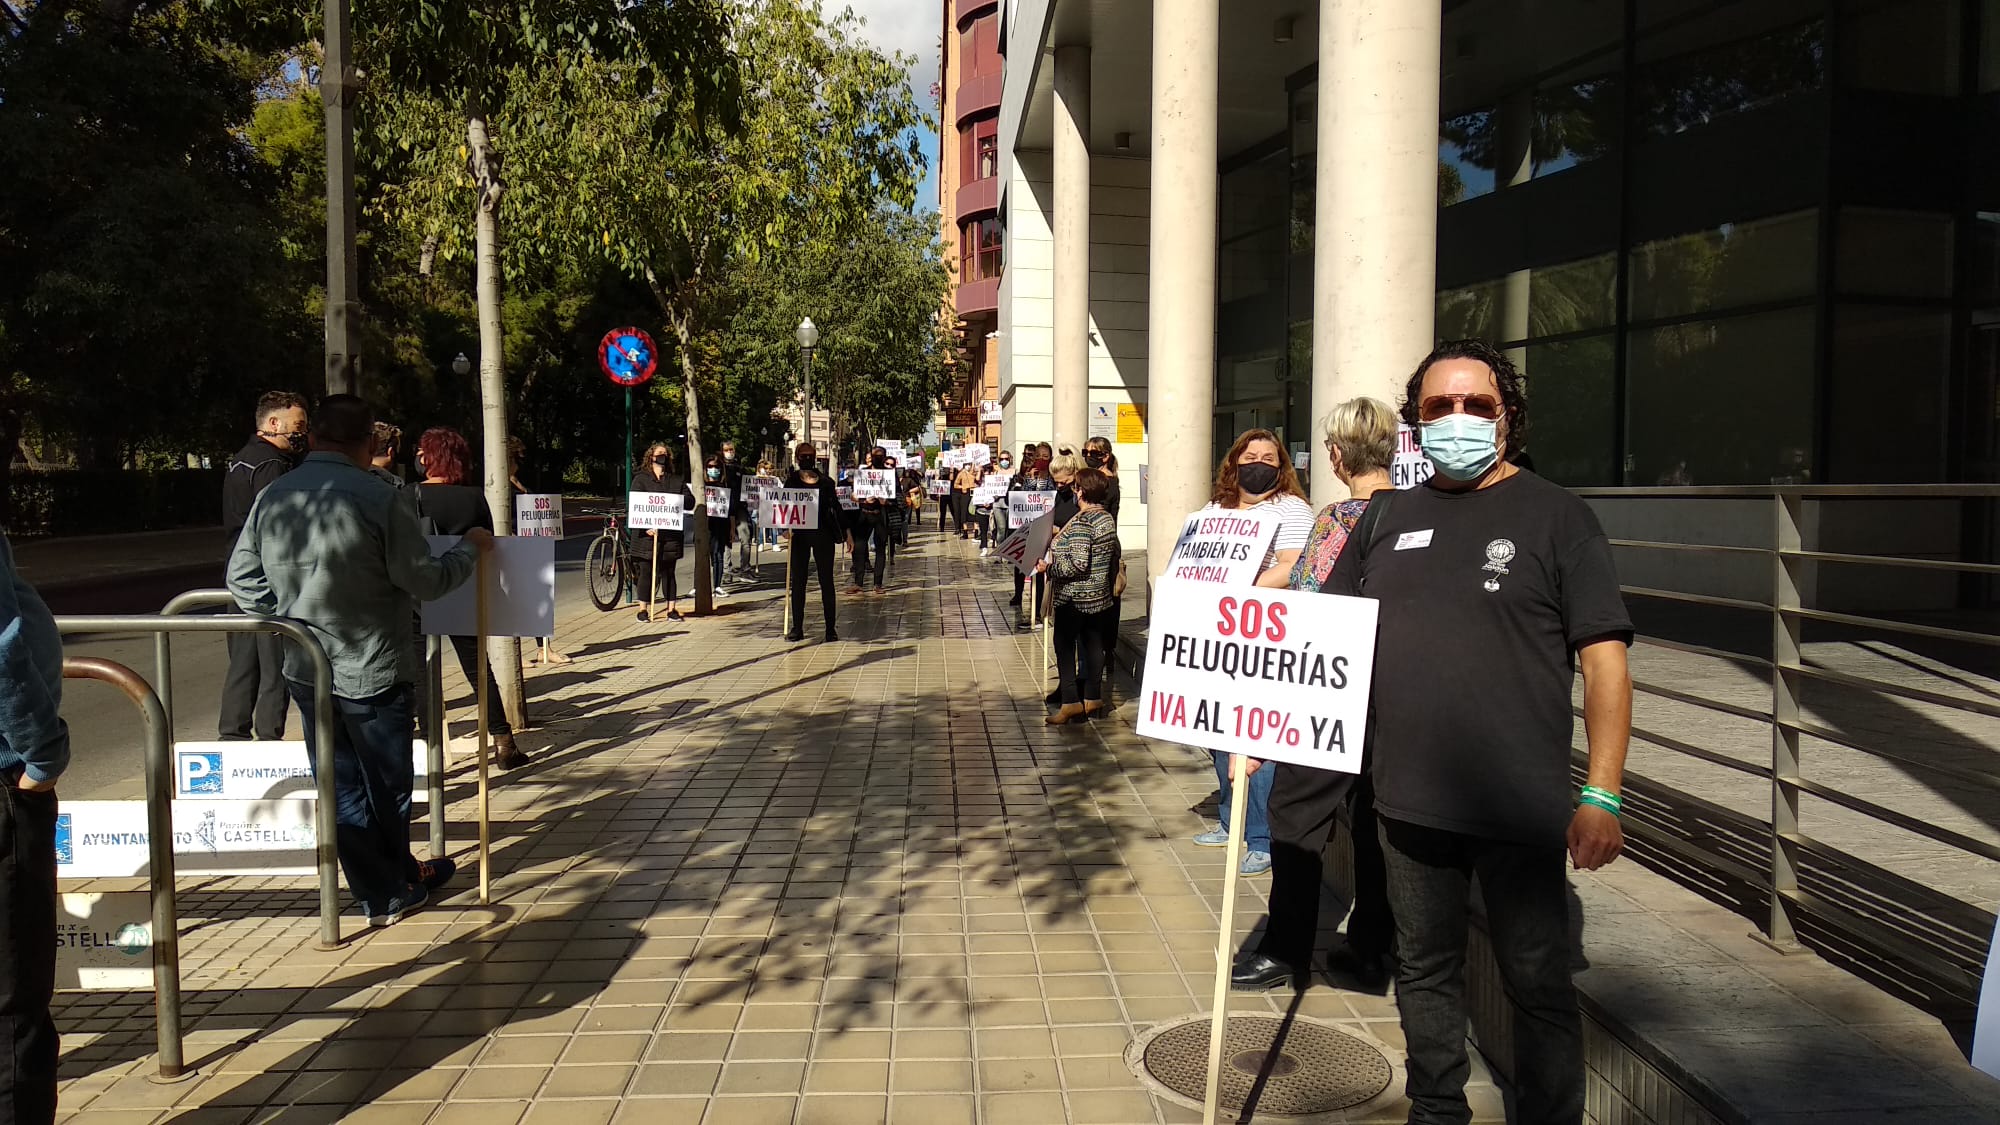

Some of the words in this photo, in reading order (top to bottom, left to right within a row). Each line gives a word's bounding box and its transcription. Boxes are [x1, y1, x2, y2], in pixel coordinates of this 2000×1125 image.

[1414, 462, 1428, 484] ES
[648, 496, 666, 504] SOS
[766, 491, 778, 500] IVA
[782, 491, 791, 501] AL
[794, 492, 813, 502] 10%
[1028, 494, 1040, 503] SOS
[534, 498, 550, 509] SOS
[634, 504, 680, 514] PELUQUERÍAS
[522, 507, 560, 520] PELUQUERÍAS
[772, 504, 806, 525] ¡YA!
[632, 517, 643, 525] IVA
[654, 518, 670, 526] 10%
[672, 519, 680, 527] YA
[1012, 518, 1023, 526] IVA
[1186, 518, 1199, 536] LA
[1200, 512, 1260, 538] ESTÉTICA
[521, 527, 532, 536] IVA
[534, 527, 540, 536] AL
[1178, 536, 1229, 560] TAMBIÉN
[1230, 543, 1250, 560] ES
[1176, 566, 1228, 583] ESENCIAL
[1217, 596, 1288, 642] SOS
[1161, 634, 1349, 690] PELUQUERÍAS
[1150, 690, 1186, 728] IVA
[1193, 699, 1224, 734] AL
[1232, 705, 1300, 746] 10%
[1310, 716, 1346, 754] YA
